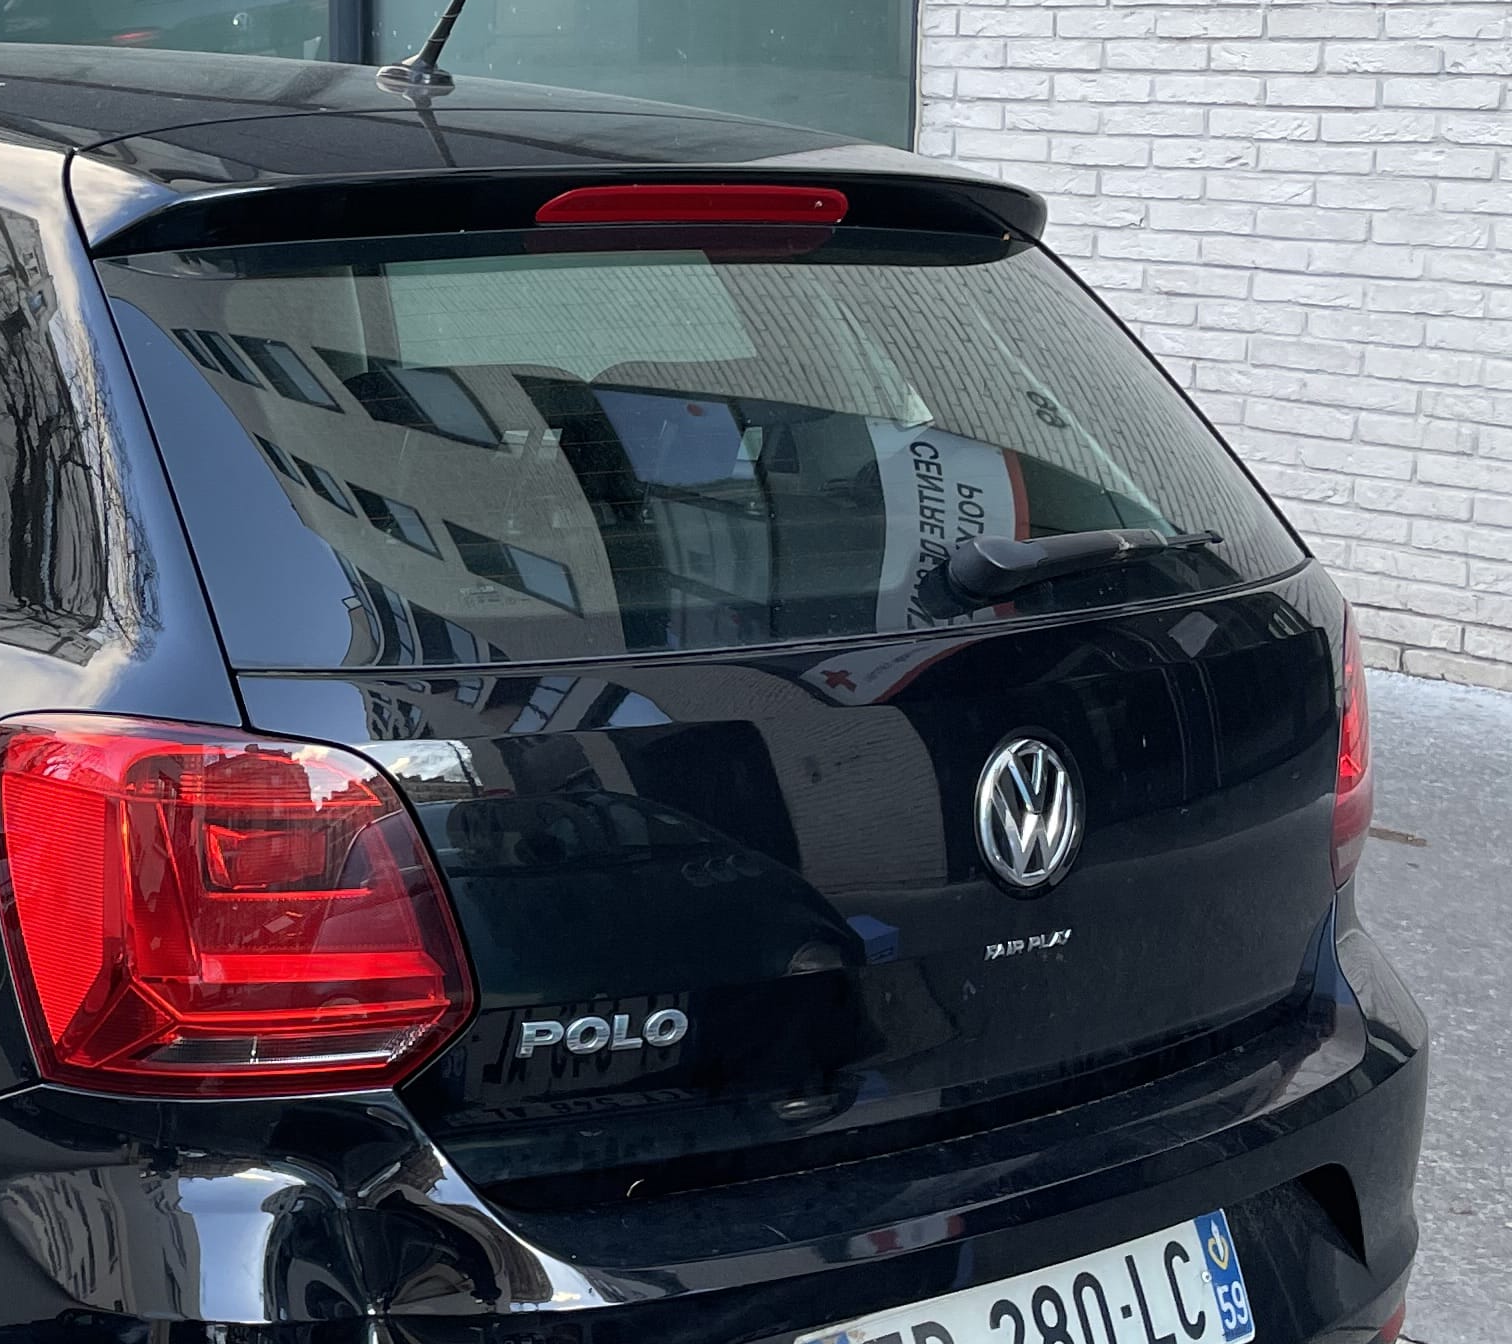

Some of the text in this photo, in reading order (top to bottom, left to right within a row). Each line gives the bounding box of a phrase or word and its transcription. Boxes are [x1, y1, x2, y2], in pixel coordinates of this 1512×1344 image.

[983, 928, 1072, 960] FAIR PLAY
[515, 1009, 688, 1058] POLO
[1216, 1280, 1249, 1330] 59
